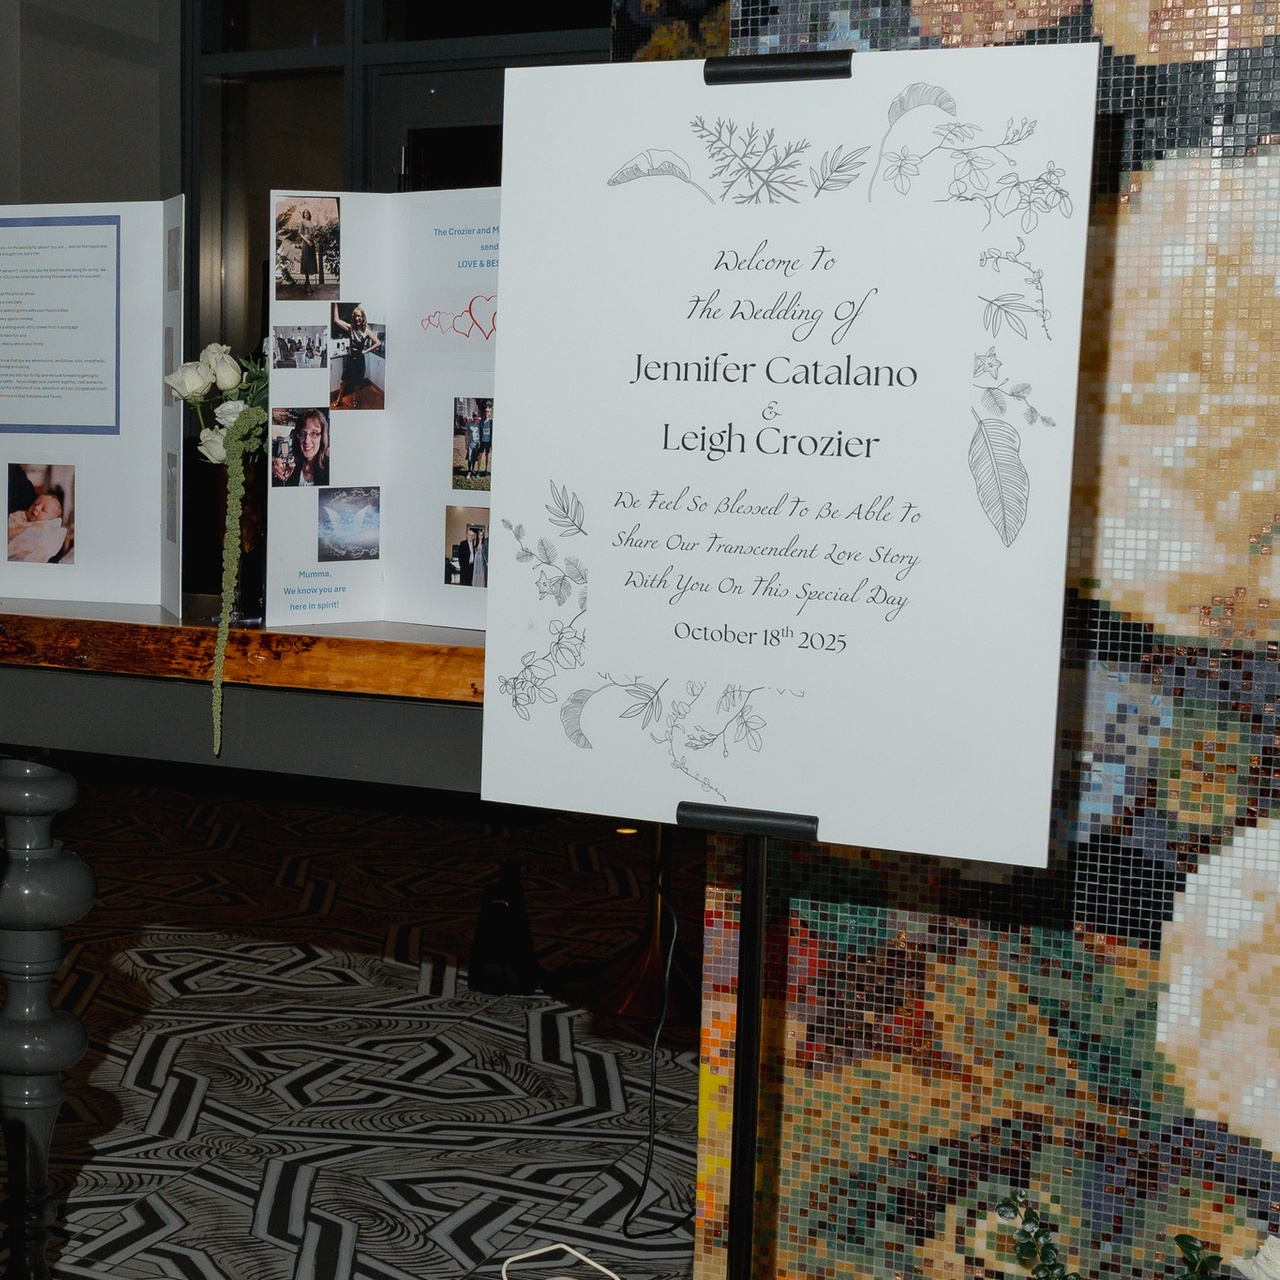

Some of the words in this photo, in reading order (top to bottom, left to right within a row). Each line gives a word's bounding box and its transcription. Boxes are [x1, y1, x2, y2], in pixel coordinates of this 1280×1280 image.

[434, 228, 447, 236] The
[448, 227, 475, 236] Crozier
[476, 226, 491, 234] and
[480, 243, 499, 251] send
[457, 260, 477, 268] LOVE
[479, 259, 485, 267] &
[714, 240, 803, 277] Welcome
[811, 246, 838, 270] To
[686, 289, 724, 319] The
[730, 291, 824, 342] Wedding
[832, 288, 878, 345] Of
[630, 353, 756, 384] Jennifer
[766, 354, 917, 387] Catalano
[762, 401, 782, 420] &
[663, 422, 746, 462] Leigh
[756, 427, 880, 458] Crozier
[614, 492, 642, 508] We
[648, 486, 690, 510] Feel
[686, 496, 708, 512] So
[714, 489, 789, 516] Blessed
[788, 496, 810, 517] To
[815, 502, 841, 520] Be
[844, 495, 894, 522] Able
[900, 502, 922, 523] To
[612, 523, 660, 548] Share
[666, 534, 700, 551] Our
[706, 533, 819, 558] Transcendent
[824, 544, 864, 565] Love
[869, 546, 921, 581] Story
[298, 570, 332, 578] Mumma,
[283, 587, 296, 595] We
[297, 587, 318, 595] know
[318, 587, 333, 595] you
[317, 601, 339, 610] spirit!
[624, 565, 674, 588] With
[669, 574, 712, 605] You
[718, 578, 745, 594] On
[752, 572, 788, 598] This
[796, 578, 868, 616] Special
[866, 585, 910, 622] Day
[674, 622, 758, 644] October
[764, 626, 794, 646] 18th
[798, 632, 846, 654] 2025
